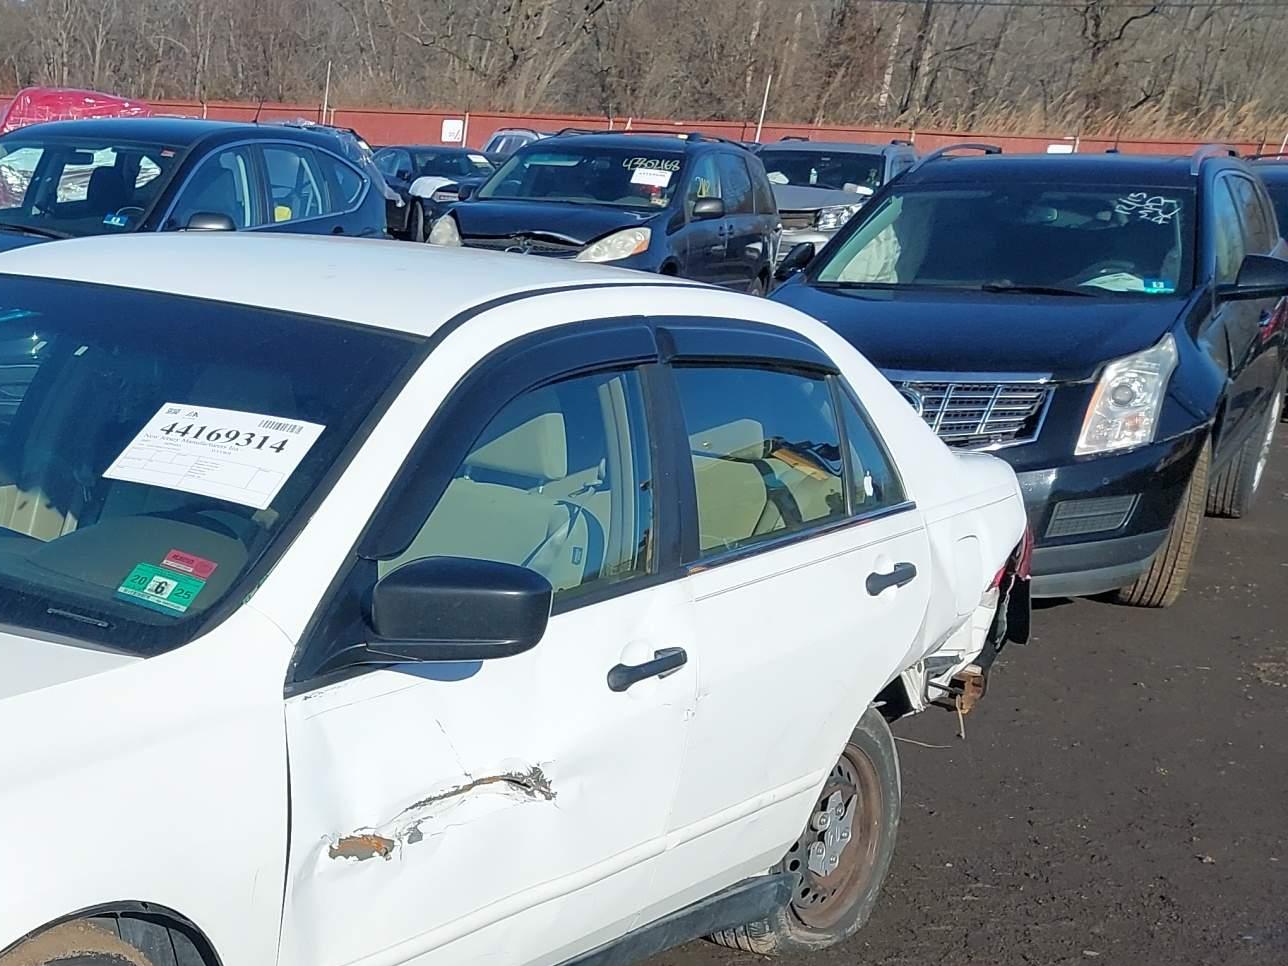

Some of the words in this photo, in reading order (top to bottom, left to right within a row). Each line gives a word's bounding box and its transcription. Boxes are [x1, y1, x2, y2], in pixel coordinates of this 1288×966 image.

[160, 421, 289, 453] 44169314
[131, 574, 148, 586] 20
[154, 581, 168, 595] 6
[174, 587, 192, 600] 25
